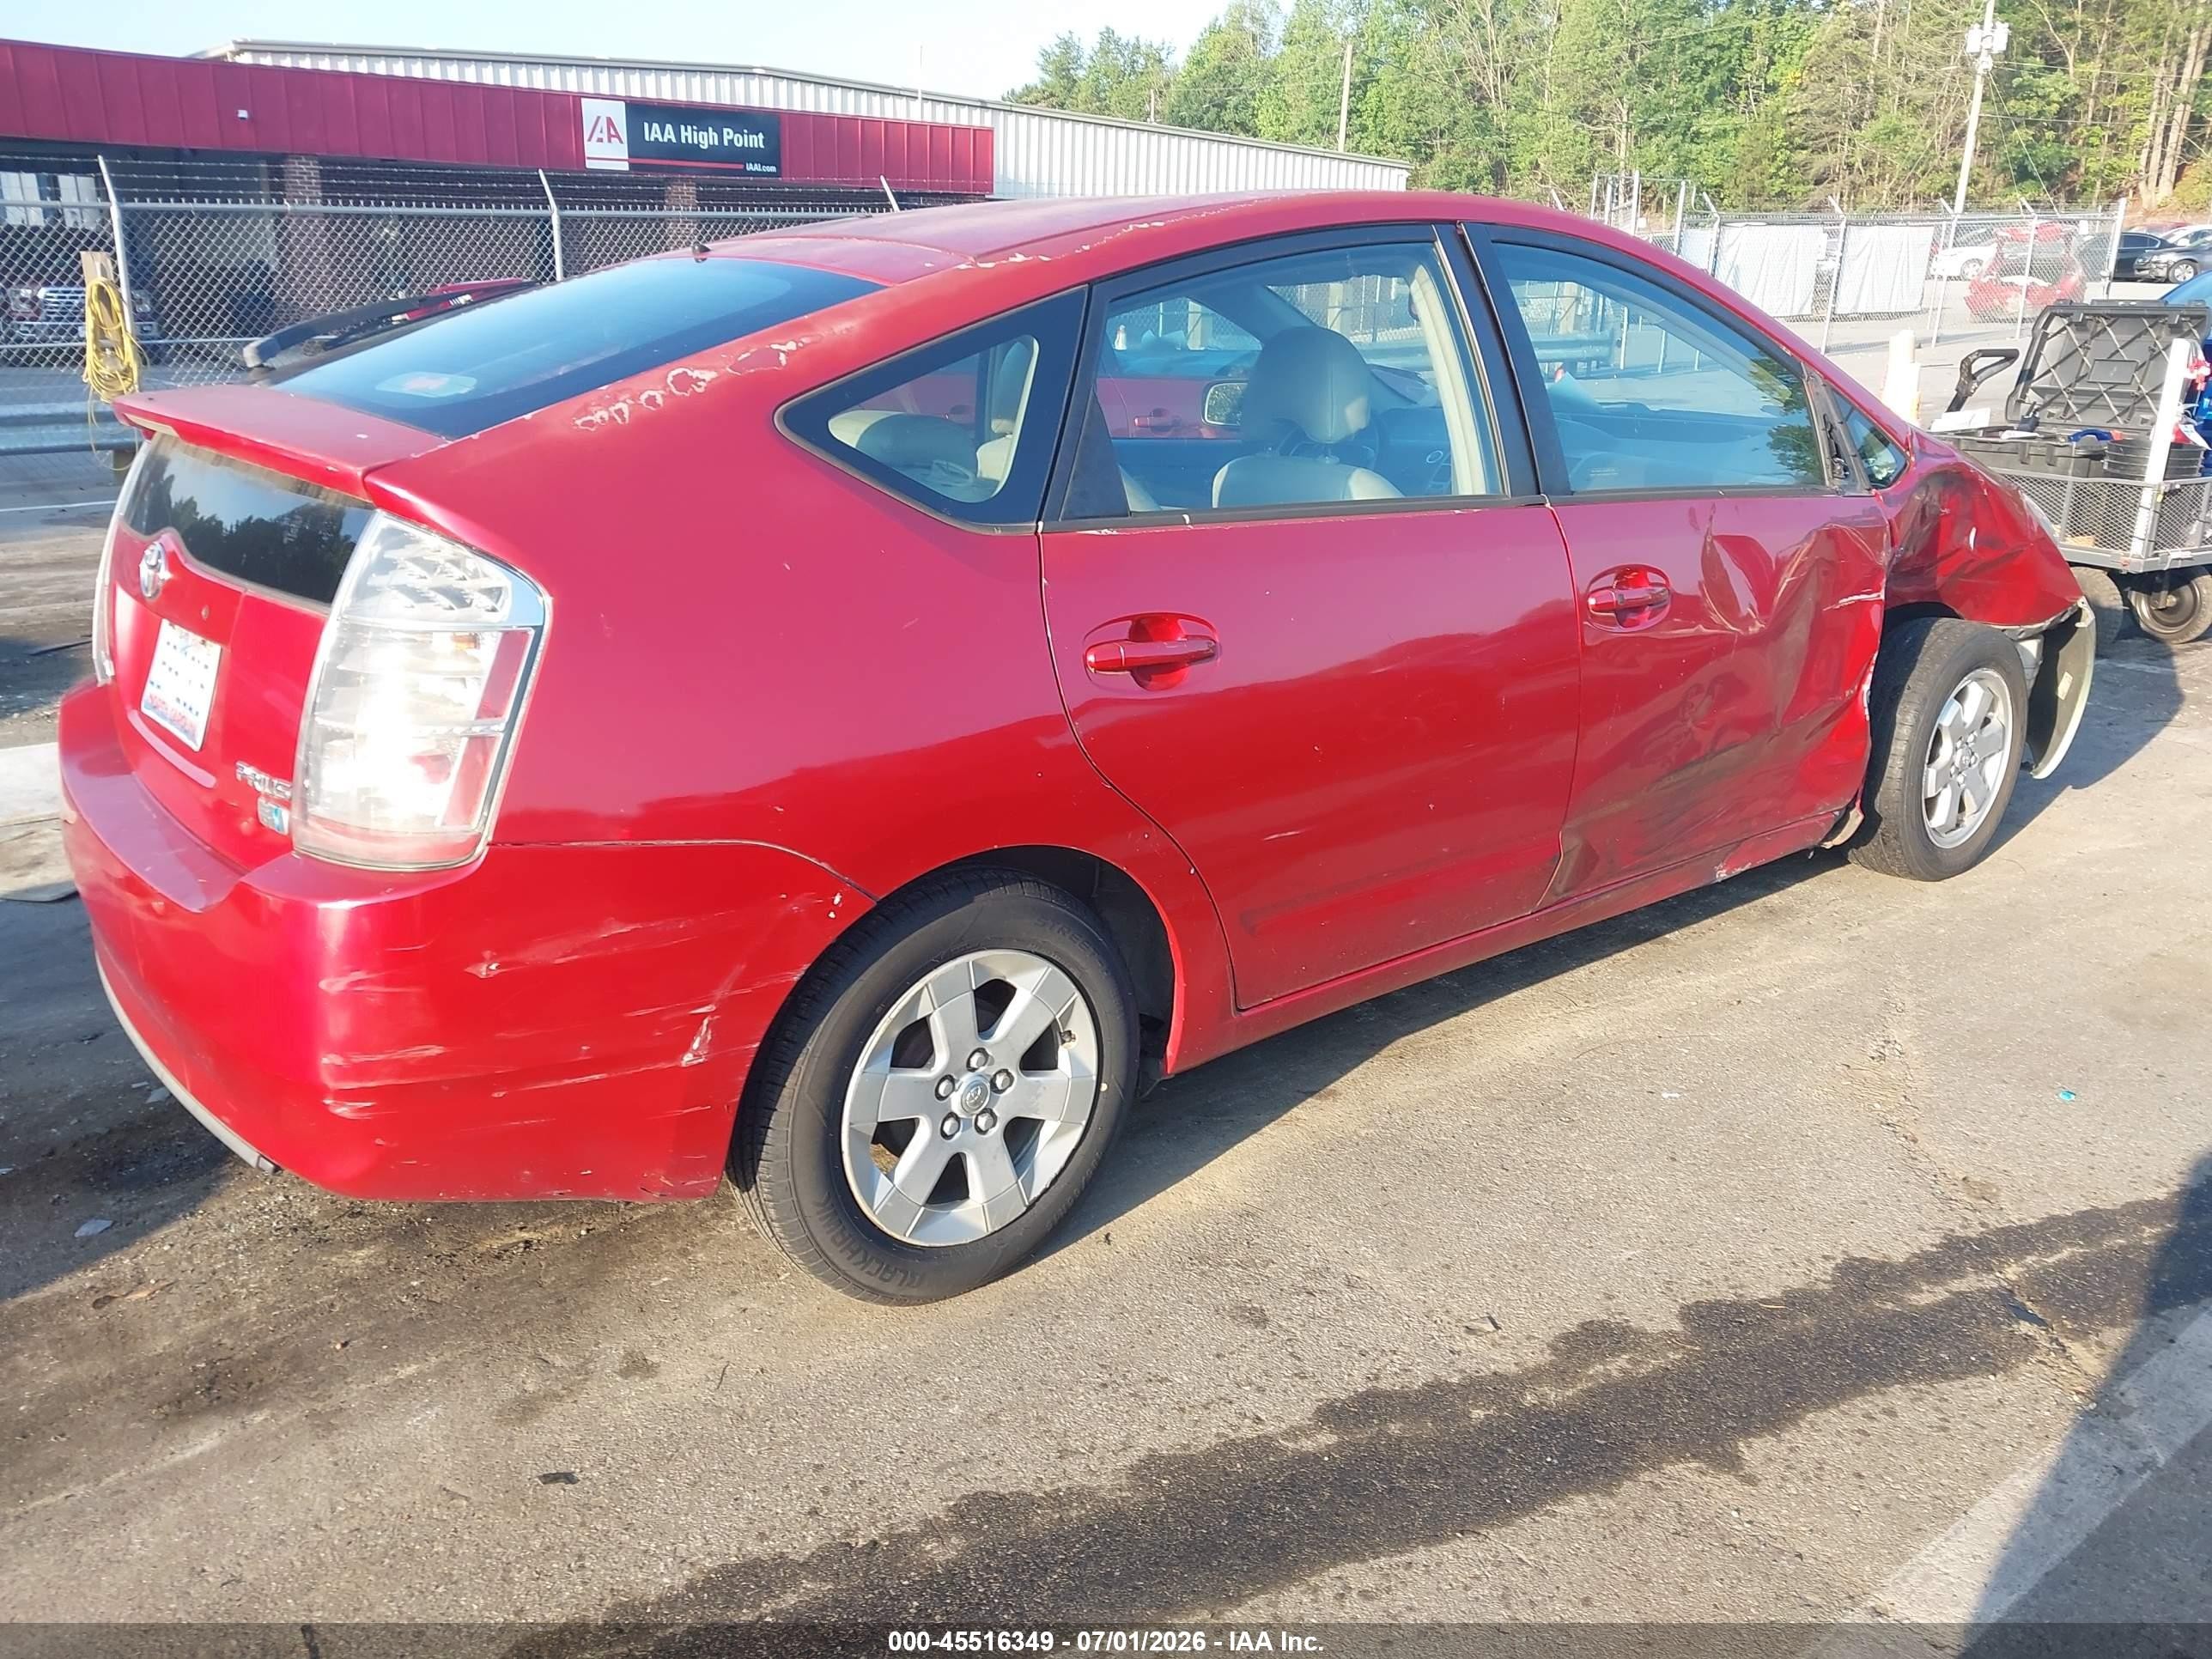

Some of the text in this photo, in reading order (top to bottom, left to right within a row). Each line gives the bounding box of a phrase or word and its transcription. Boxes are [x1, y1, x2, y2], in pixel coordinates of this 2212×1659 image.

[643, 121, 765, 149] IAA High Point
